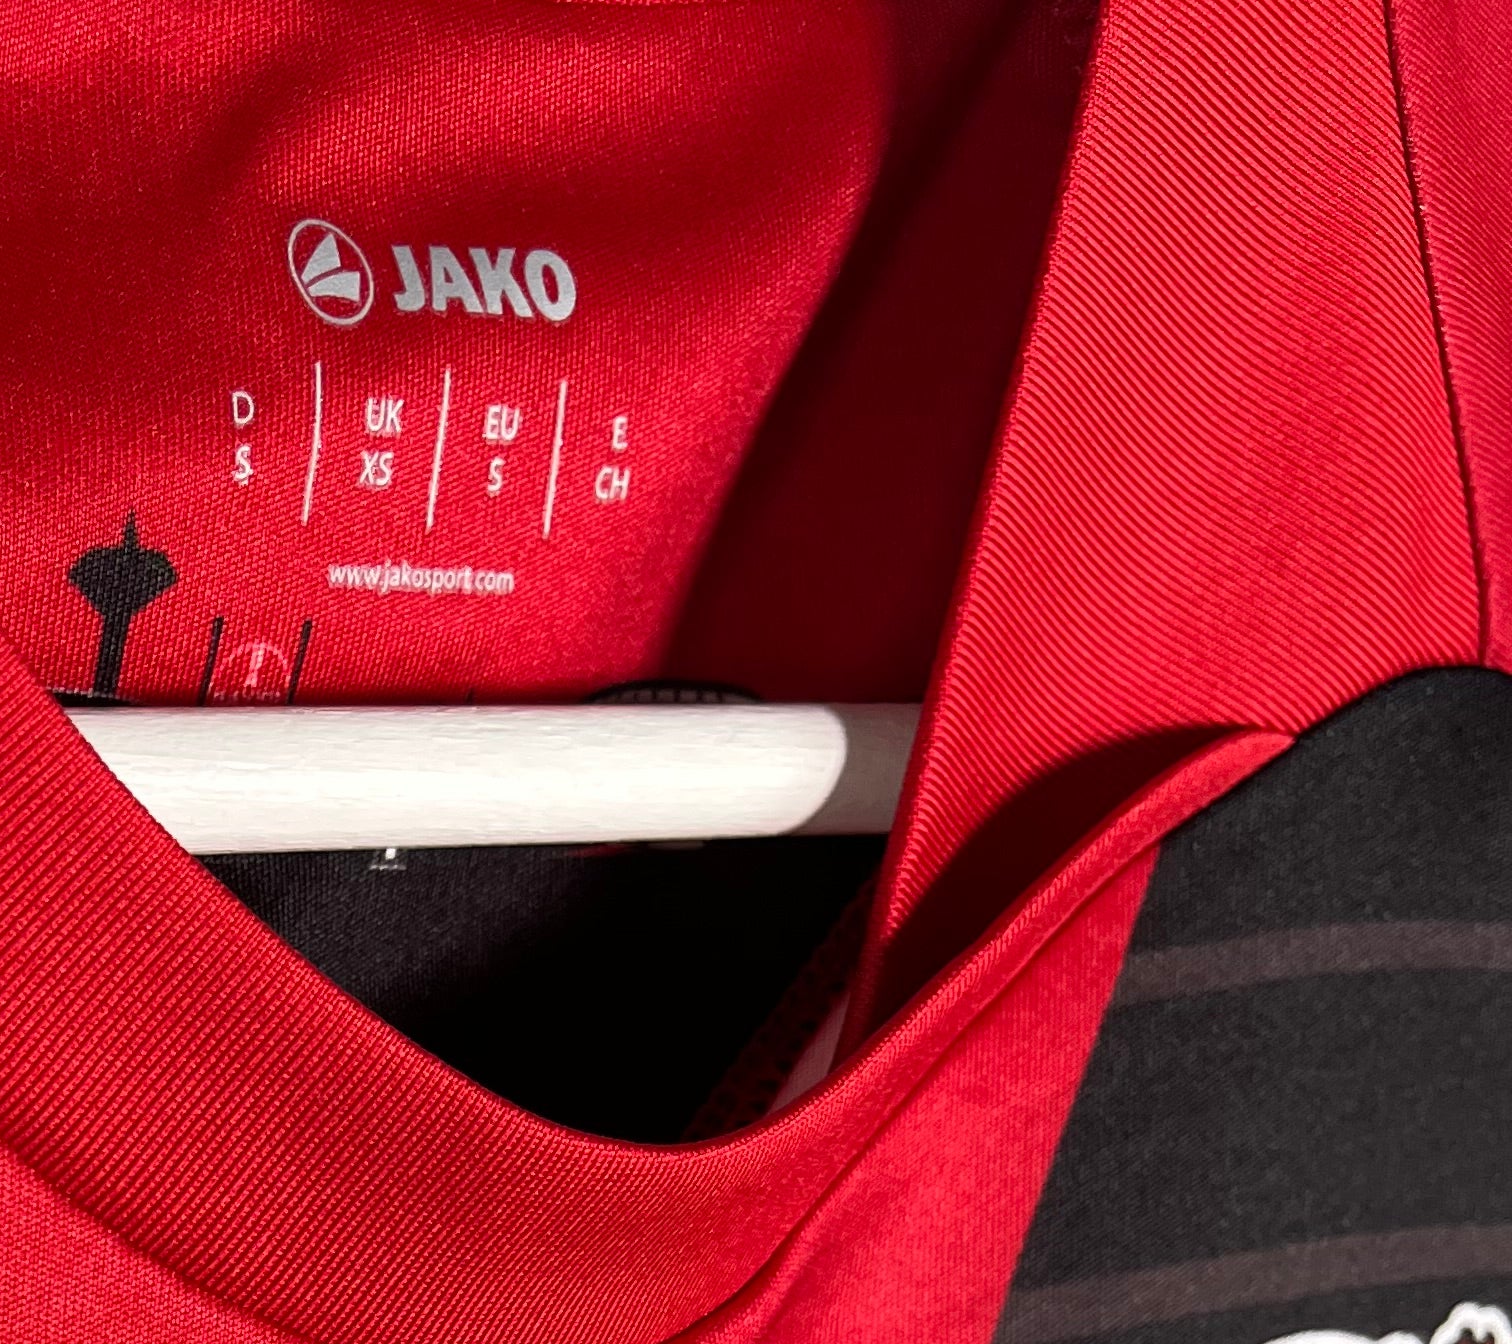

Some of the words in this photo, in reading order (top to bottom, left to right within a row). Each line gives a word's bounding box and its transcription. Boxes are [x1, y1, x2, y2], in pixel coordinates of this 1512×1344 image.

[391, 245, 578, 321] JAKO
[231, 390, 256, 426] D
[364, 398, 404, 434] UK
[482, 404, 521, 442] EU
[612, 416, 629, 451] E
[232, 444, 255, 485] S
[358, 451, 394, 488] XS
[488, 457, 506, 493] S
[594, 466, 630, 500] CH
[327, 560, 515, 596] www.jakosport.com
